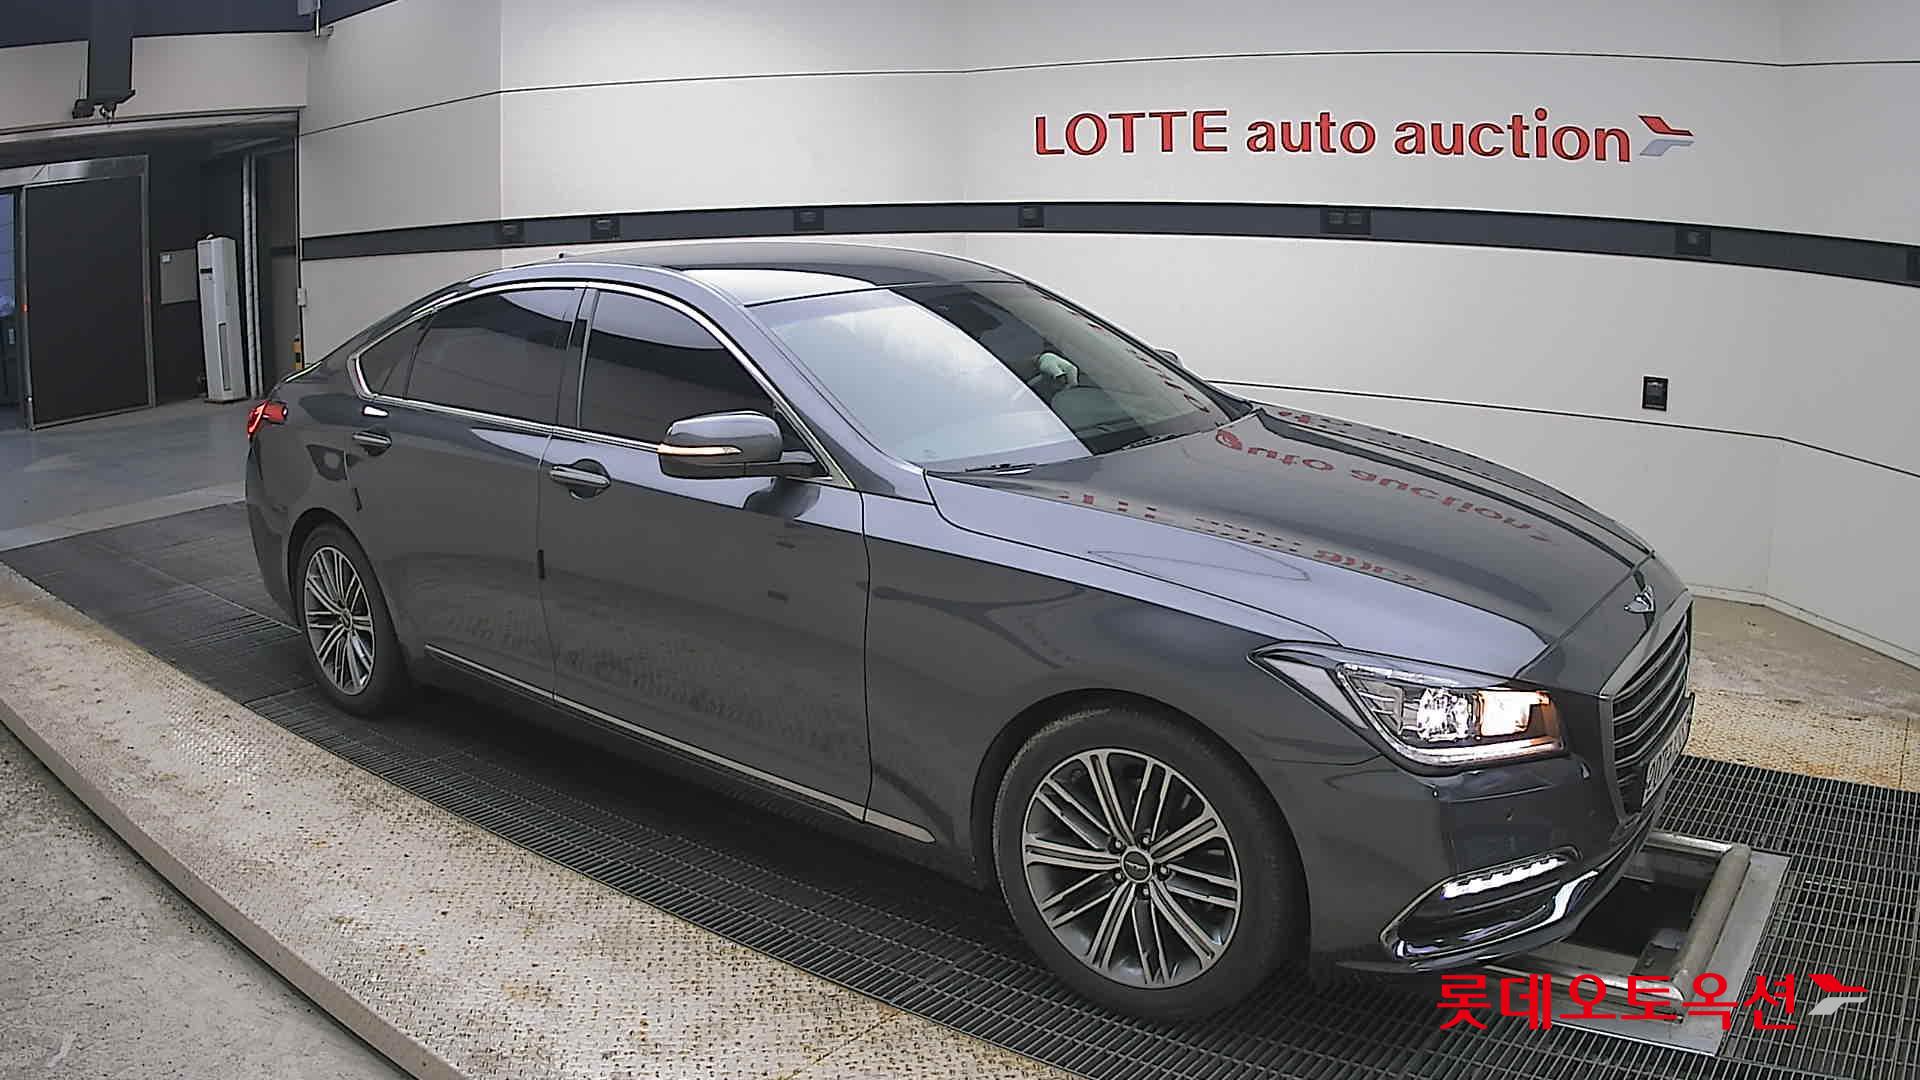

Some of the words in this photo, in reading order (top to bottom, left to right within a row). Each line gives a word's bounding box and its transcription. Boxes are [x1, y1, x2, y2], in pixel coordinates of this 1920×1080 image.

[1035, 110, 1228, 156] LOTTE
[1246, 112, 1376, 154] auto
[1394, 107, 1631, 163] auction
